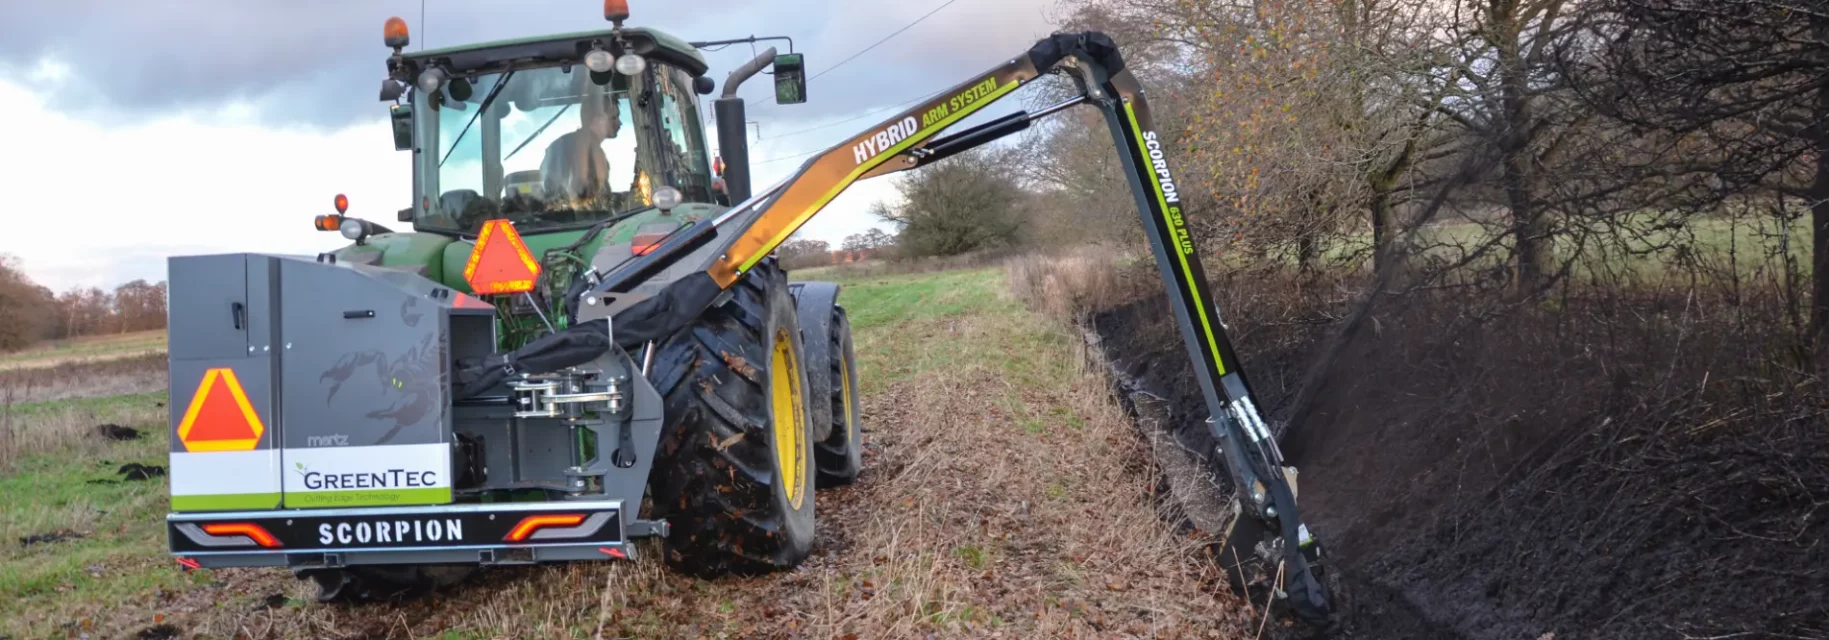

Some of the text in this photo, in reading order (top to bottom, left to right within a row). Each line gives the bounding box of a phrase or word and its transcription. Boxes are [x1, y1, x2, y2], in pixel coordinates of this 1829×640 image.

[852, 77, 997, 164] HYBRID ARM SYSTEM
[1143, 131, 1194, 254] SCORPION 630 PLUS
[319, 519, 462, 544] SCORPION
